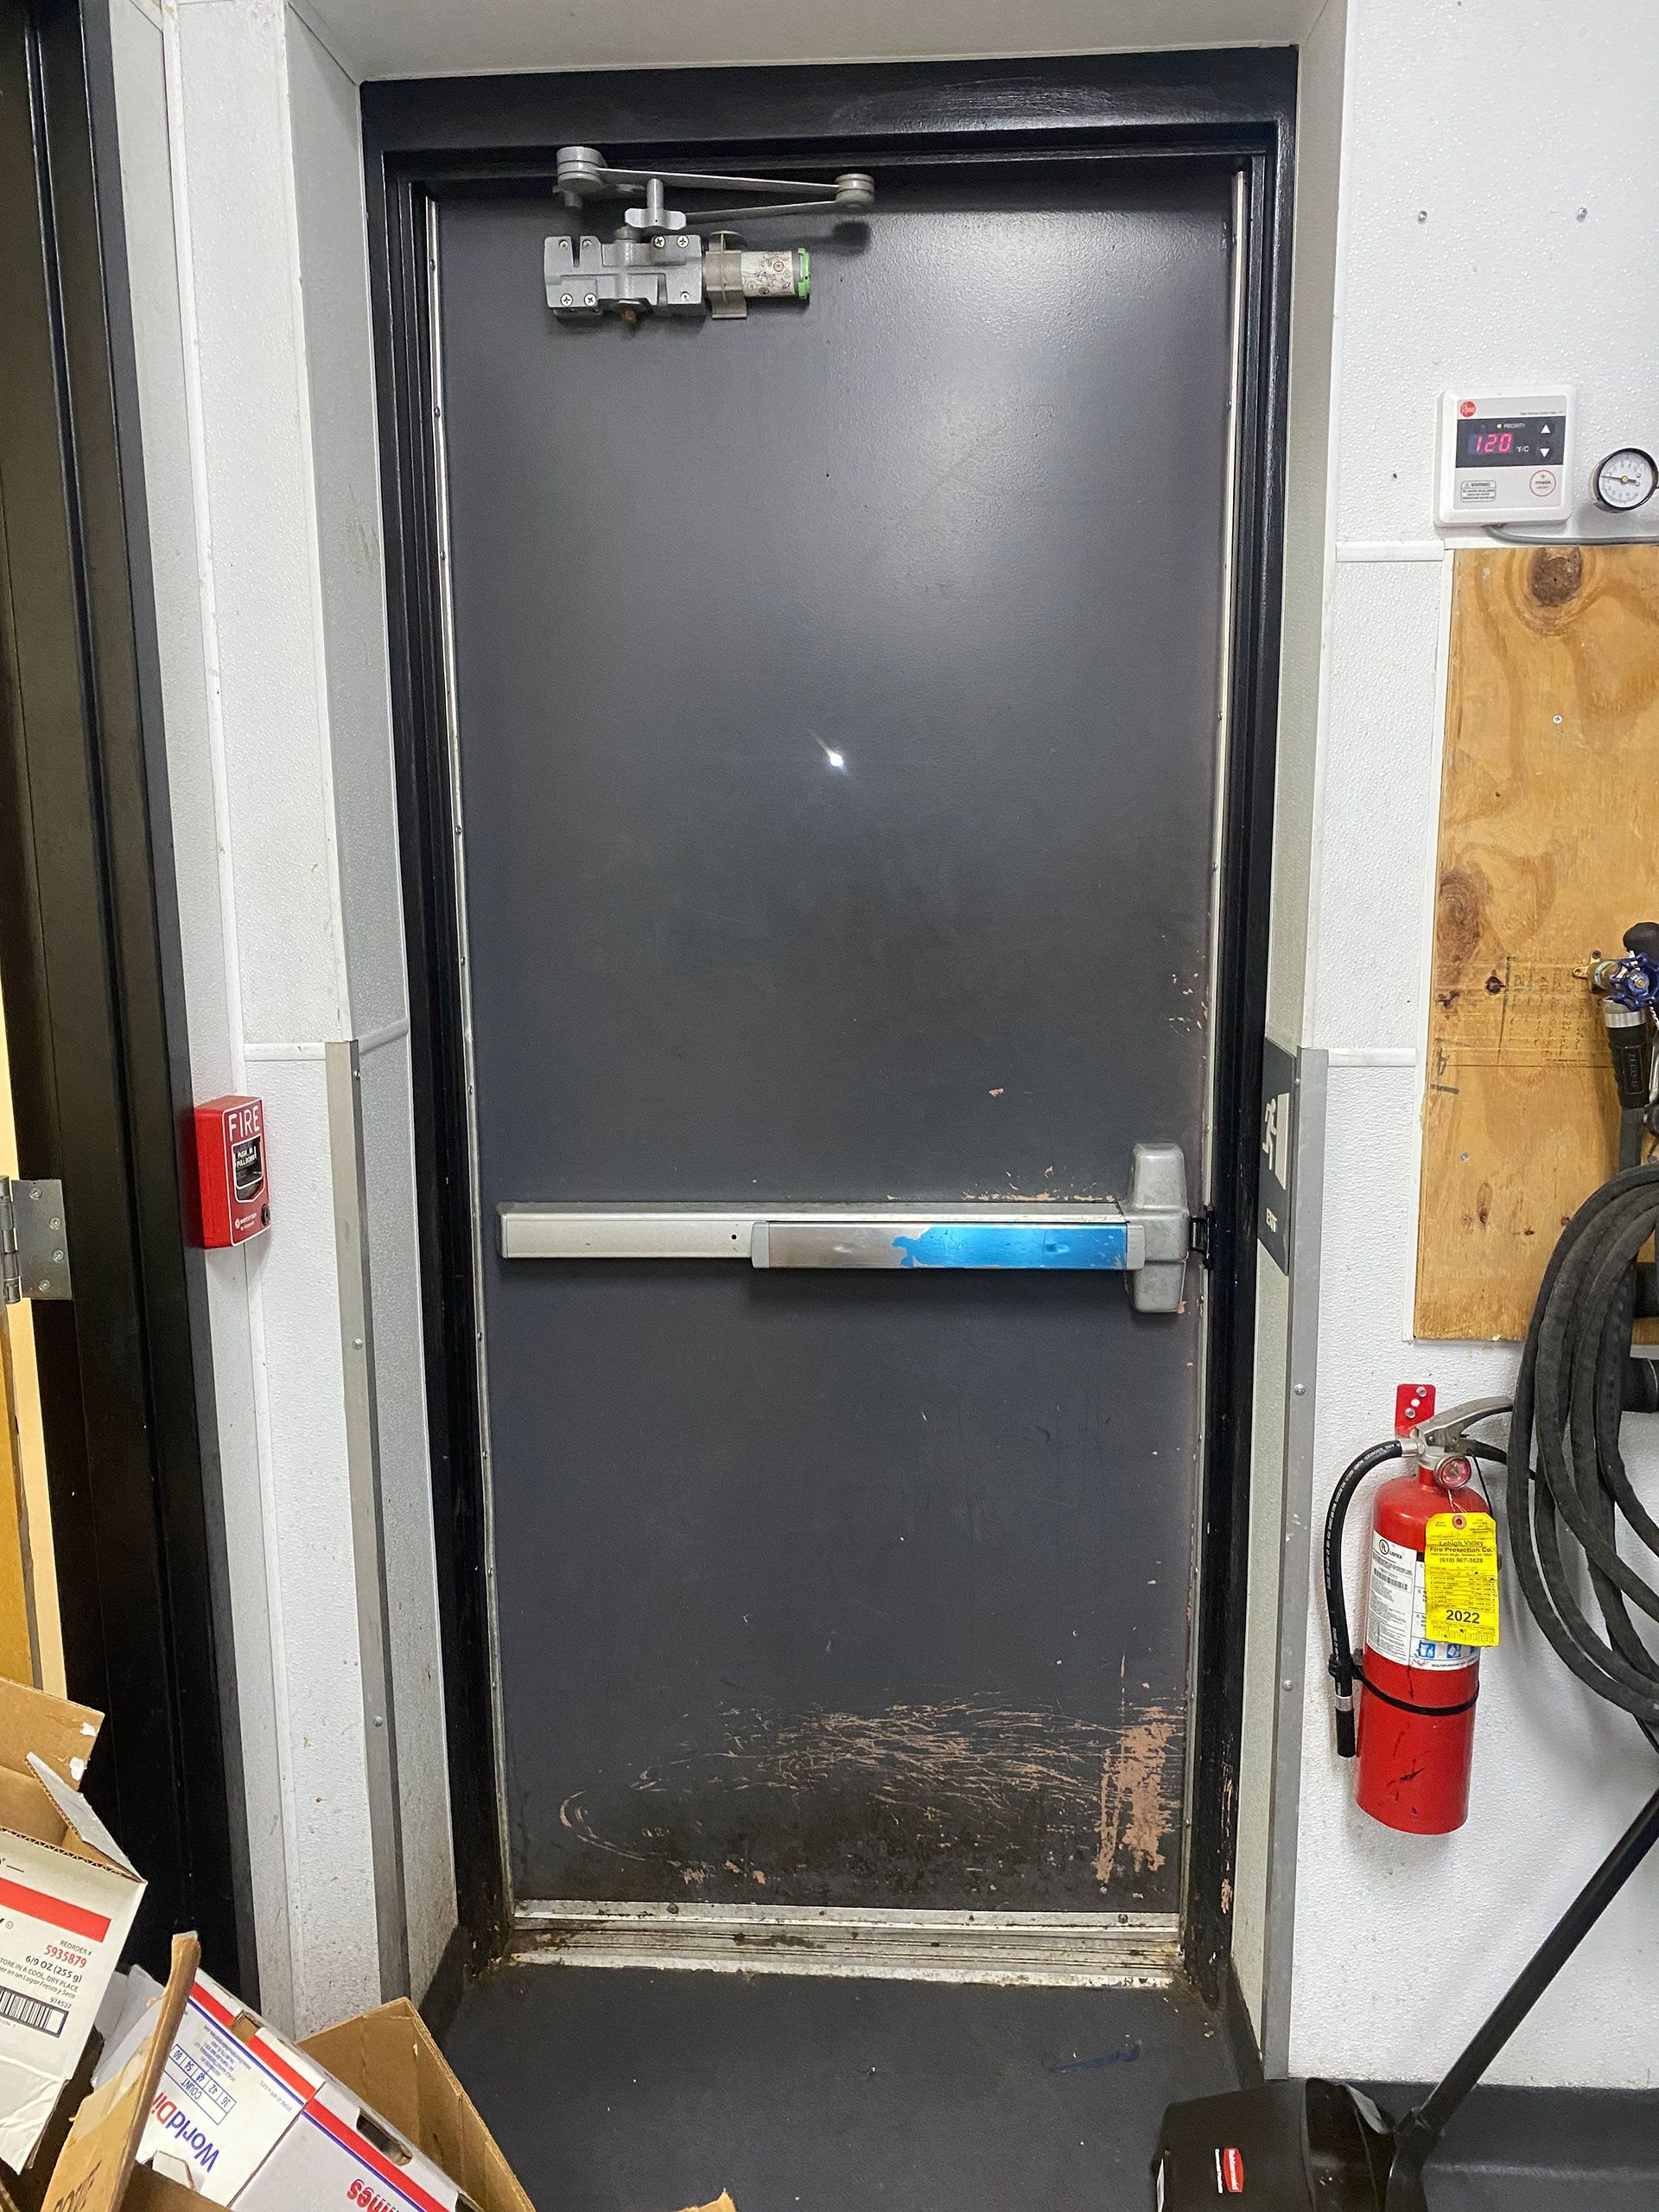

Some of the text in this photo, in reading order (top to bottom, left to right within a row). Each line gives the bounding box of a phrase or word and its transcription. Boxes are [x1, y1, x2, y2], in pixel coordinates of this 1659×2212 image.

[1476, 433, 1512, 454] 120
[228, 1105, 260, 1141] FIRE
[1446, 1610, 1480, 1624] 2022
[44, 1944, 87, 1968] 5935879
[60, 1940, 87, 1955] REORDER
[0, 1957, 15, 1968] TORE
[47, 1975, 59, 1986] DRY
[60, 1980, 79, 1993] PLACE
[25, 1955, 83, 1984] 6/9 OZ (255 g)
[22, 1975, 40, 1986] Lugar
[40, 1981, 58, 1993] Fresco
[63, 1989, 76, 1999] Seco
[50, 1998, 72, 2010] 974527
[173, 2050, 231, 2108] 36 42 48 54 60
[181, 2078, 203, 2101] COUNT
